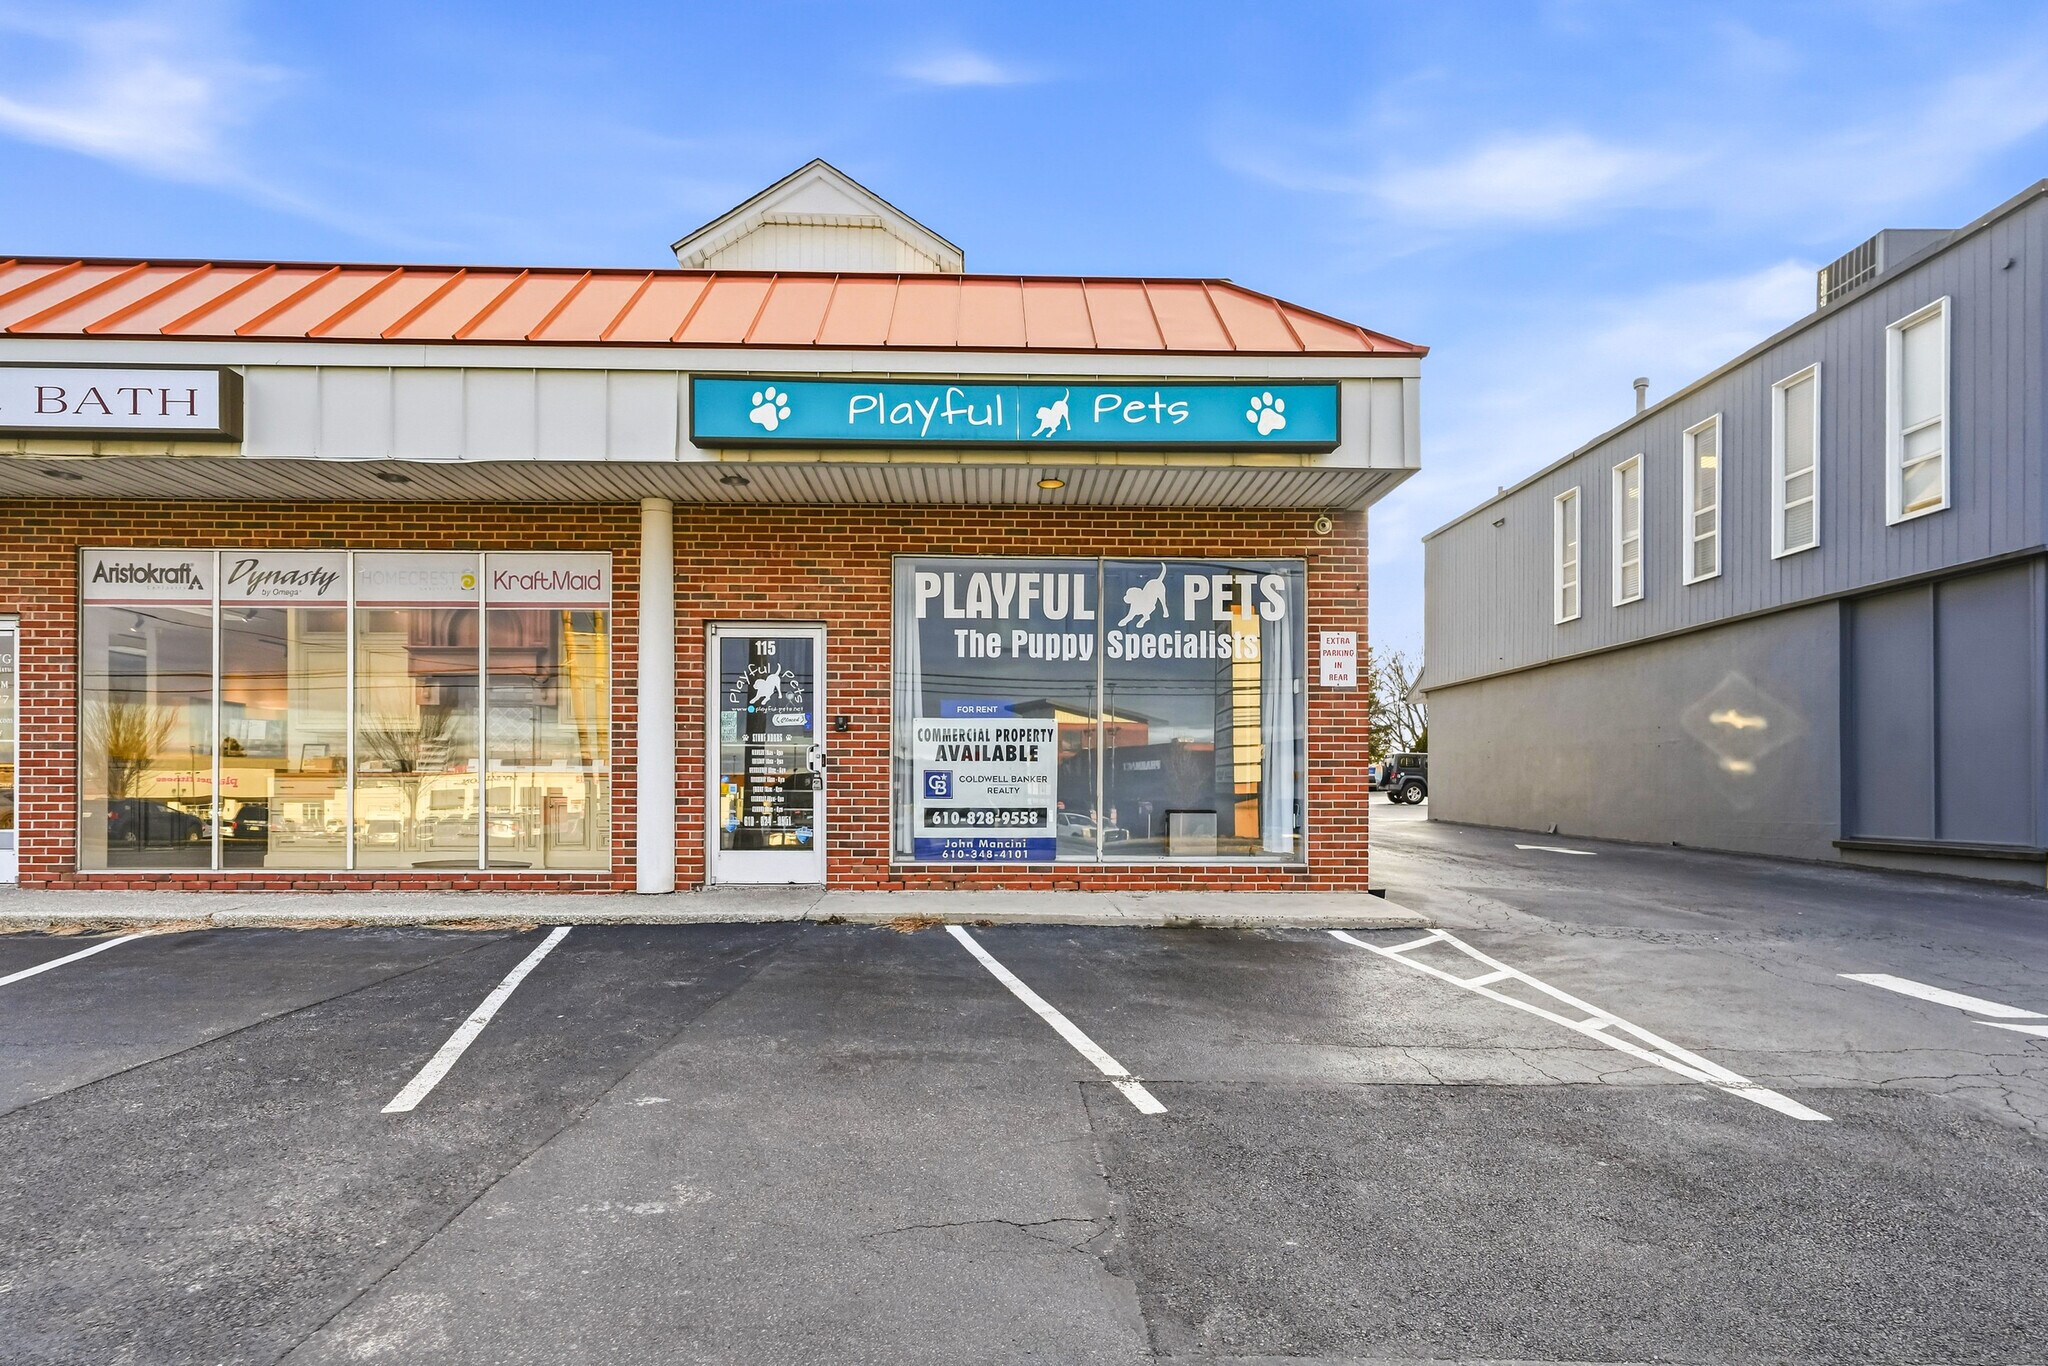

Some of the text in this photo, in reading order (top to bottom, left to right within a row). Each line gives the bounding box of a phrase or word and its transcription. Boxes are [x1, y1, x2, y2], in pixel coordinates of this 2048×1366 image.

[34, 385, 199, 416] BATH
[849, 386, 1190, 438] Playful Pets
[92, 560, 193, 584] Aristokraft
[227, 558, 340, 597] Dynasty
[361, 570, 456, 586] HOMECREST
[493, 569, 602, 591] KraftMaid
[262, 588, 299, 597] by Omega
[914, 571, 1286, 622] PLAYFUL PETS
[755, 640, 777, 656] 115
[954, 629, 1261, 661] The Puppy Specialists
[1326, 637, 1351, 645] EXTRA
[1322, 649, 1355, 657] PARKING
[1334, 661, 1343, 669] IN
[729, 662, 806, 704] Playful Pets
[1328, 673, 1349, 681] REAR
[957, 705, 998, 714] FOR RENT
[917, 727, 1054, 743] COMMERCIAL PROPERTY
[934, 744, 1039, 762] AVAILABLE
[959, 775, 1048, 784] COLDWELL BANKER
[987, 786, 1020, 795] REALTY
[932, 811, 1038, 825] 610-828-9558
[944, 839, 1027, 849] John Mancini
[942, 849, 1029, 860] 610-348-4101
